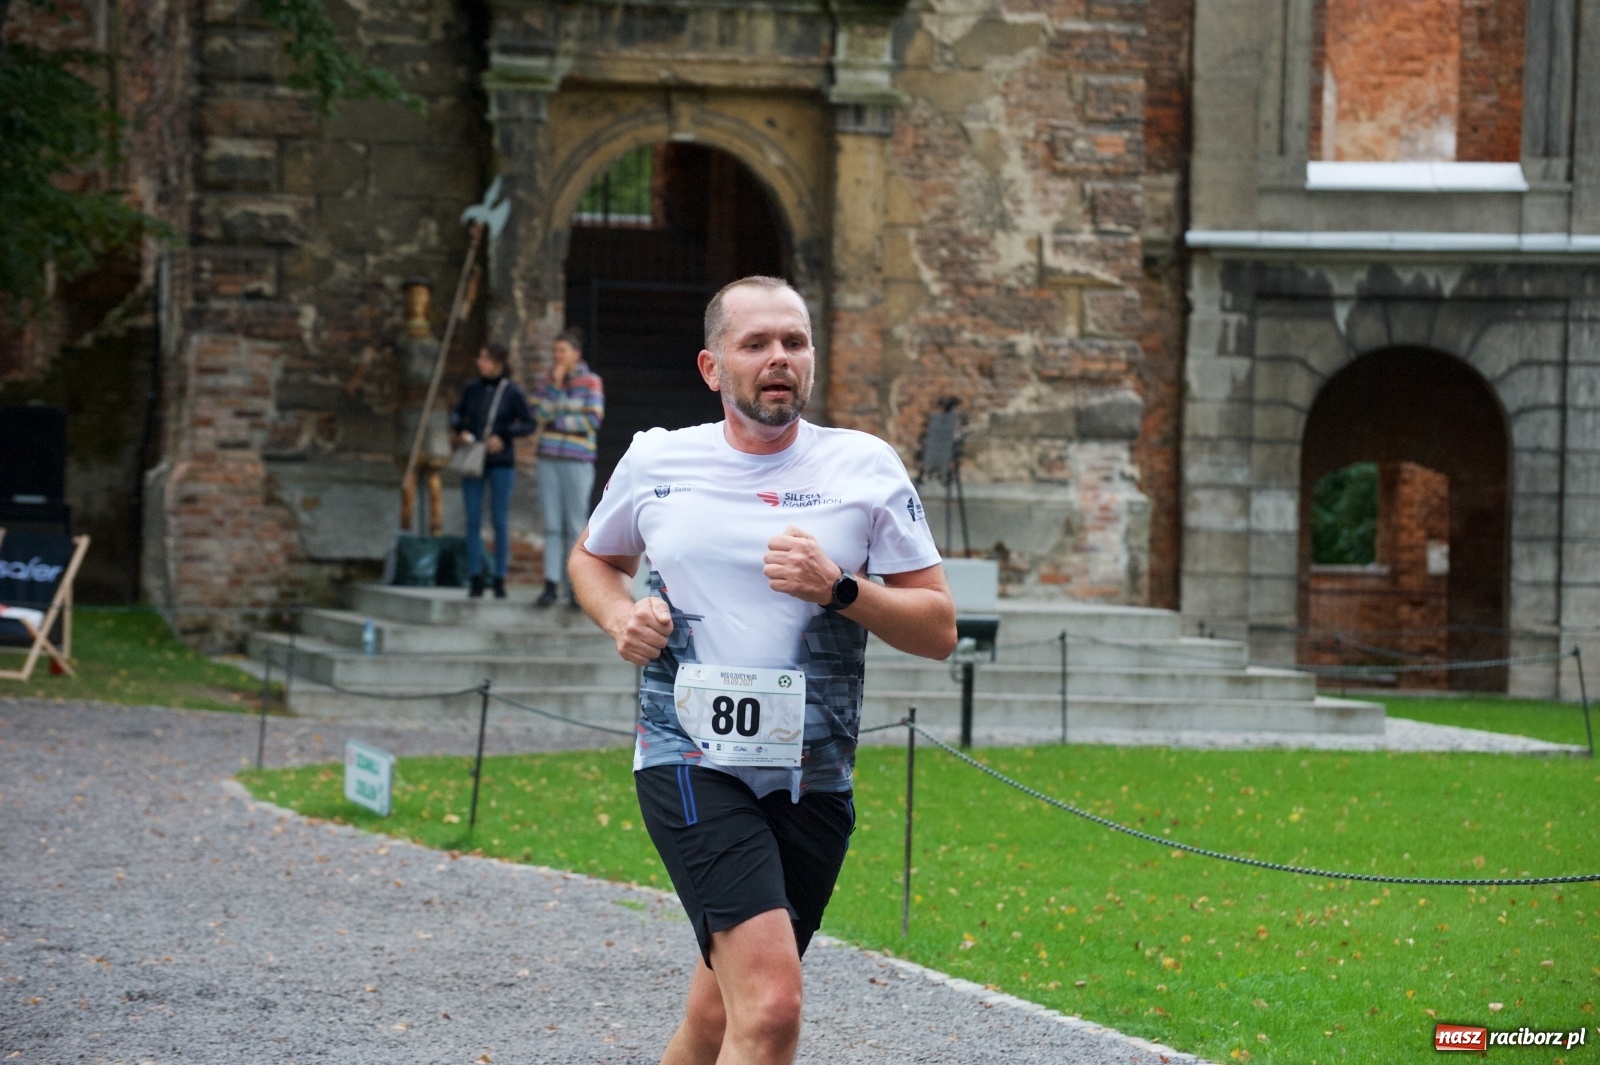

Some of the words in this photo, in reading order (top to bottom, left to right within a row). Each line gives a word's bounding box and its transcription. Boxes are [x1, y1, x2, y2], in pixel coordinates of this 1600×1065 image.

[784, 492, 821, 501] SILESIA
[782, 498, 842, 508] MARATHON
[711, 695, 761, 738] 80
